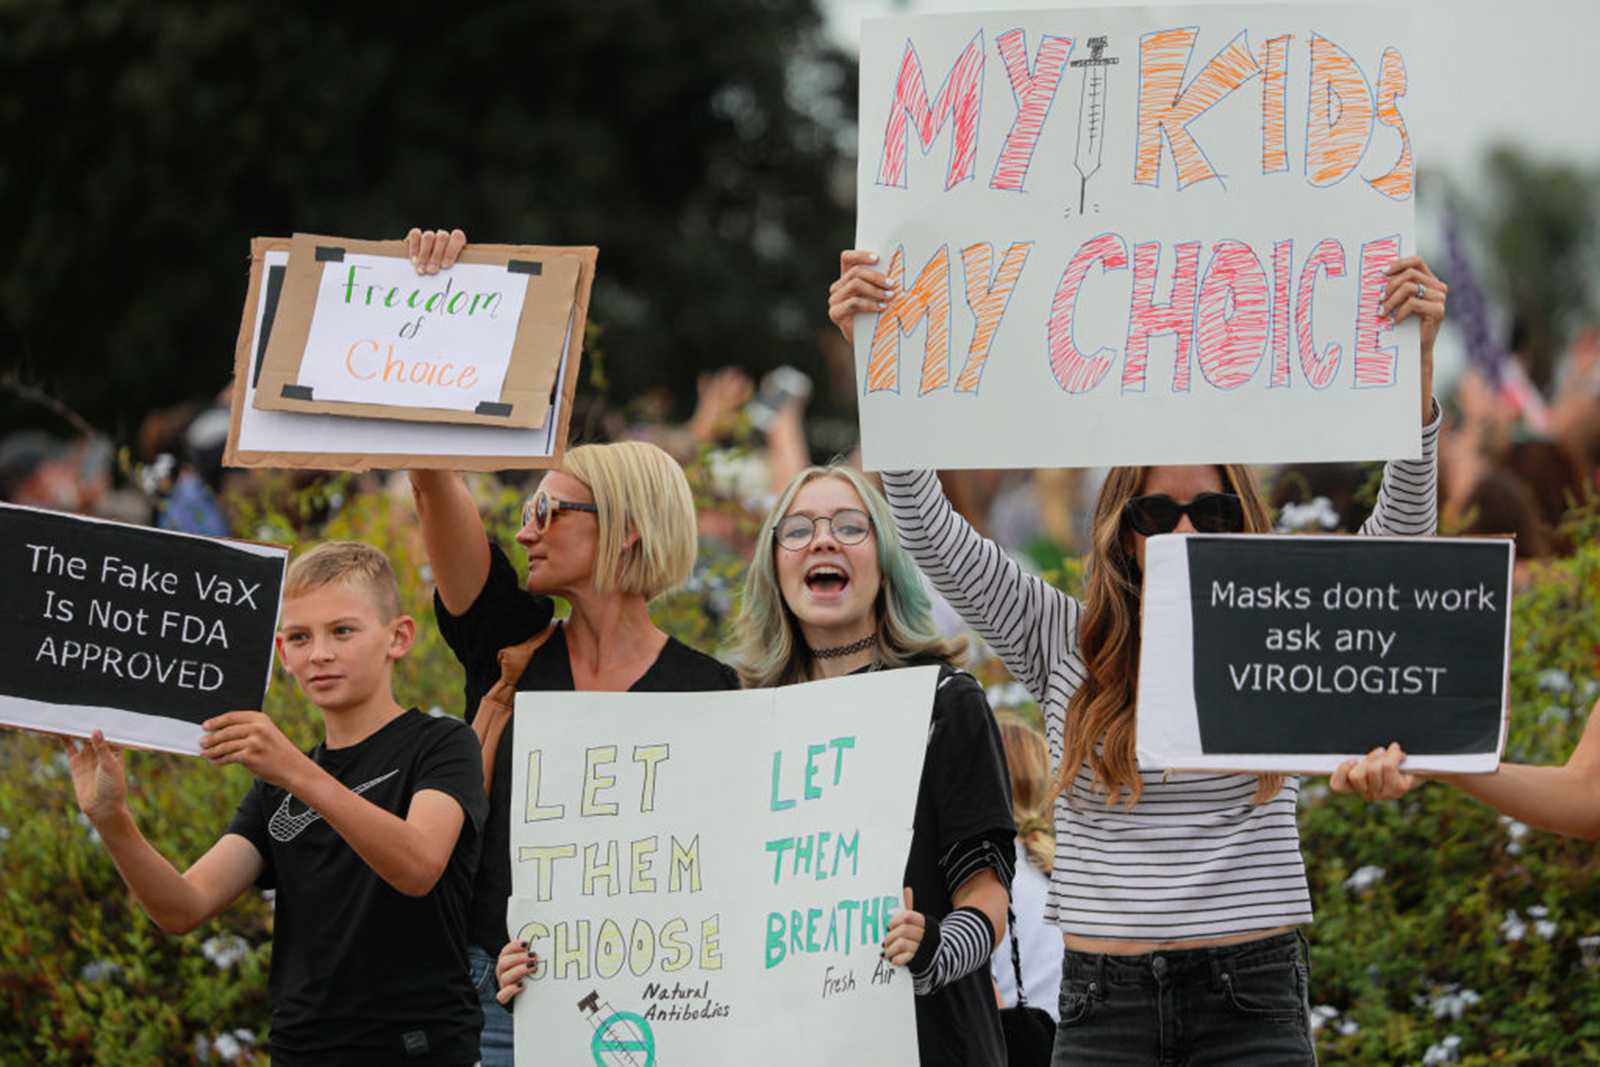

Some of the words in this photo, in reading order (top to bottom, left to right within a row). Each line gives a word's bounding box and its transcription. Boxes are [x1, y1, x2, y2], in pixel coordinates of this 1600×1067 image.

[876, 28, 1076, 193] MY
[1133, 26, 1413, 201] KIDS
[342, 265, 502, 318] Freedom
[864, 240, 1035, 397] MY
[1047, 233, 1401, 394] CHOICE
[399, 316, 425, 339] of
[345, 339, 480, 390] Choice
[26, 543, 87, 580] The
[101, 556, 178, 594] Fake
[43, 590, 74, 622] Is
[88, 599, 149, 635] Not
[160, 611, 229, 649] FDA
[1211, 580, 1311, 610] Masks
[1323, 582, 1400, 610] dont
[1414, 583, 1497, 612] work
[35, 636, 224, 691] APPROVED
[1265, 622, 1321, 651] ask
[1335, 629, 1396, 658] any
[1228, 663, 1447, 695] VIROLOGIST
[524, 743, 670, 824] LET
[769, 736, 856, 812] LET
[518, 833, 703, 902] THEM
[765, 829, 859, 885] THEM
[516, 913, 723, 981] CHOOSE
[641, 980, 709, 1001] Natural
[822, 966, 857, 999] Fresh
[871, 957, 897, 986] Air
[642, 1002, 731, 1022] Antibodies
